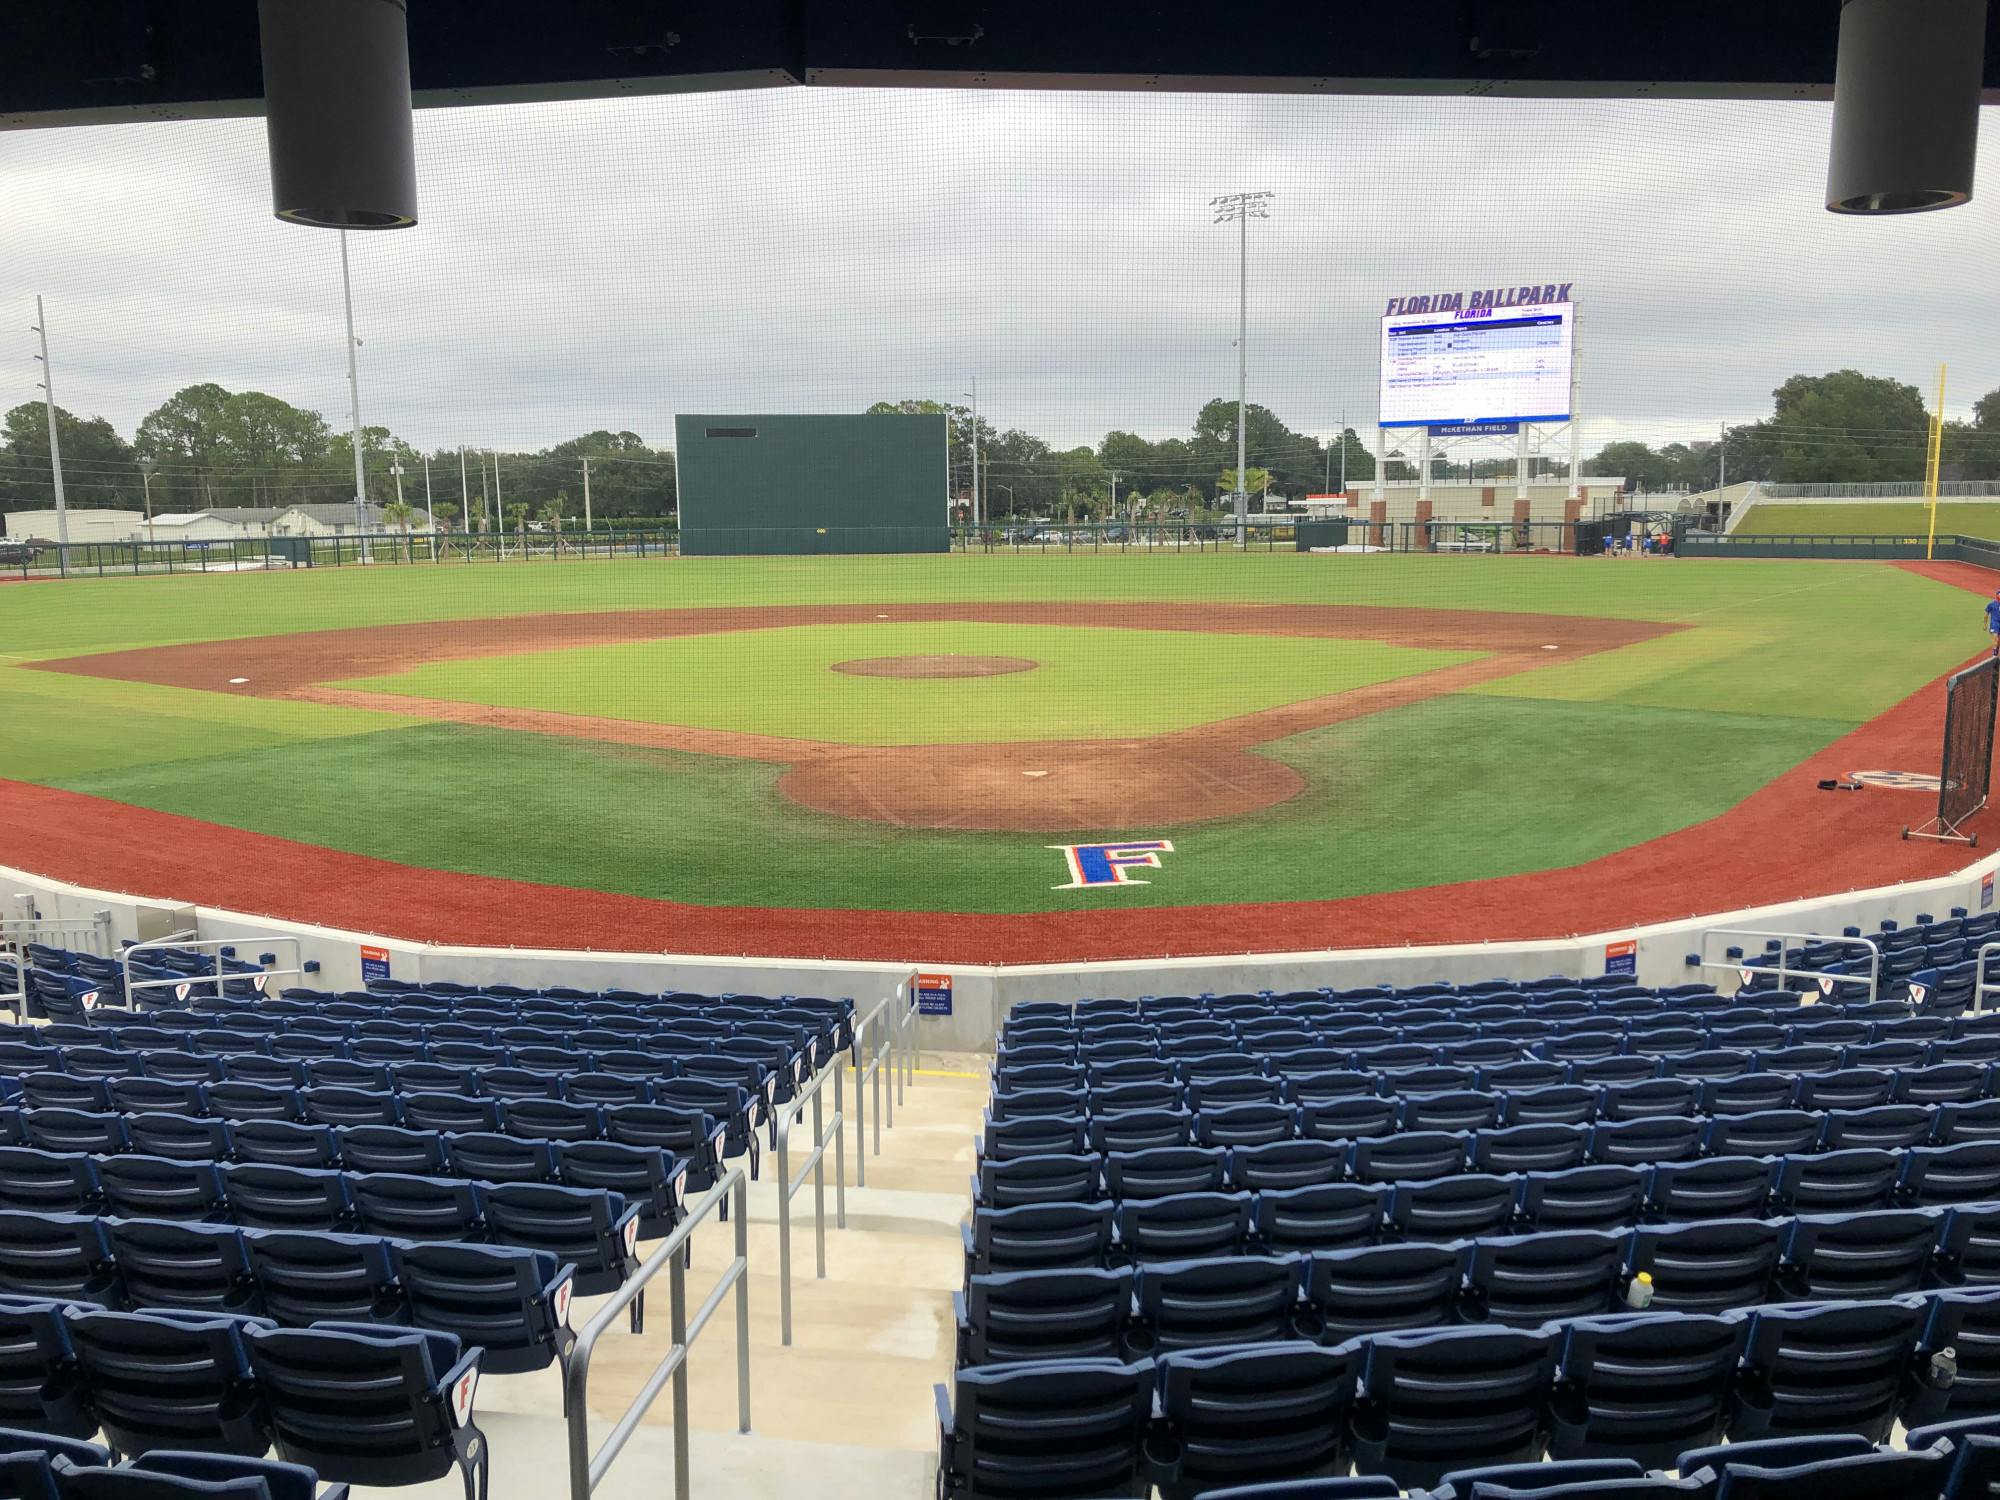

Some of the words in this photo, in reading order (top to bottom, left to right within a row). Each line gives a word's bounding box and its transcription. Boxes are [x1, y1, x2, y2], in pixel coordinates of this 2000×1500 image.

[1386, 290, 1463, 316] FLORIDA
[1469, 283, 1573, 310] BALLPARK
[1454, 309, 1492, 320] FLORIDA
[1044, 840, 1175, 889] F
[627, 1220, 636, 1243] F
[559, 1283, 568, 1313] F
[460, 1374, 470, 1412] F
